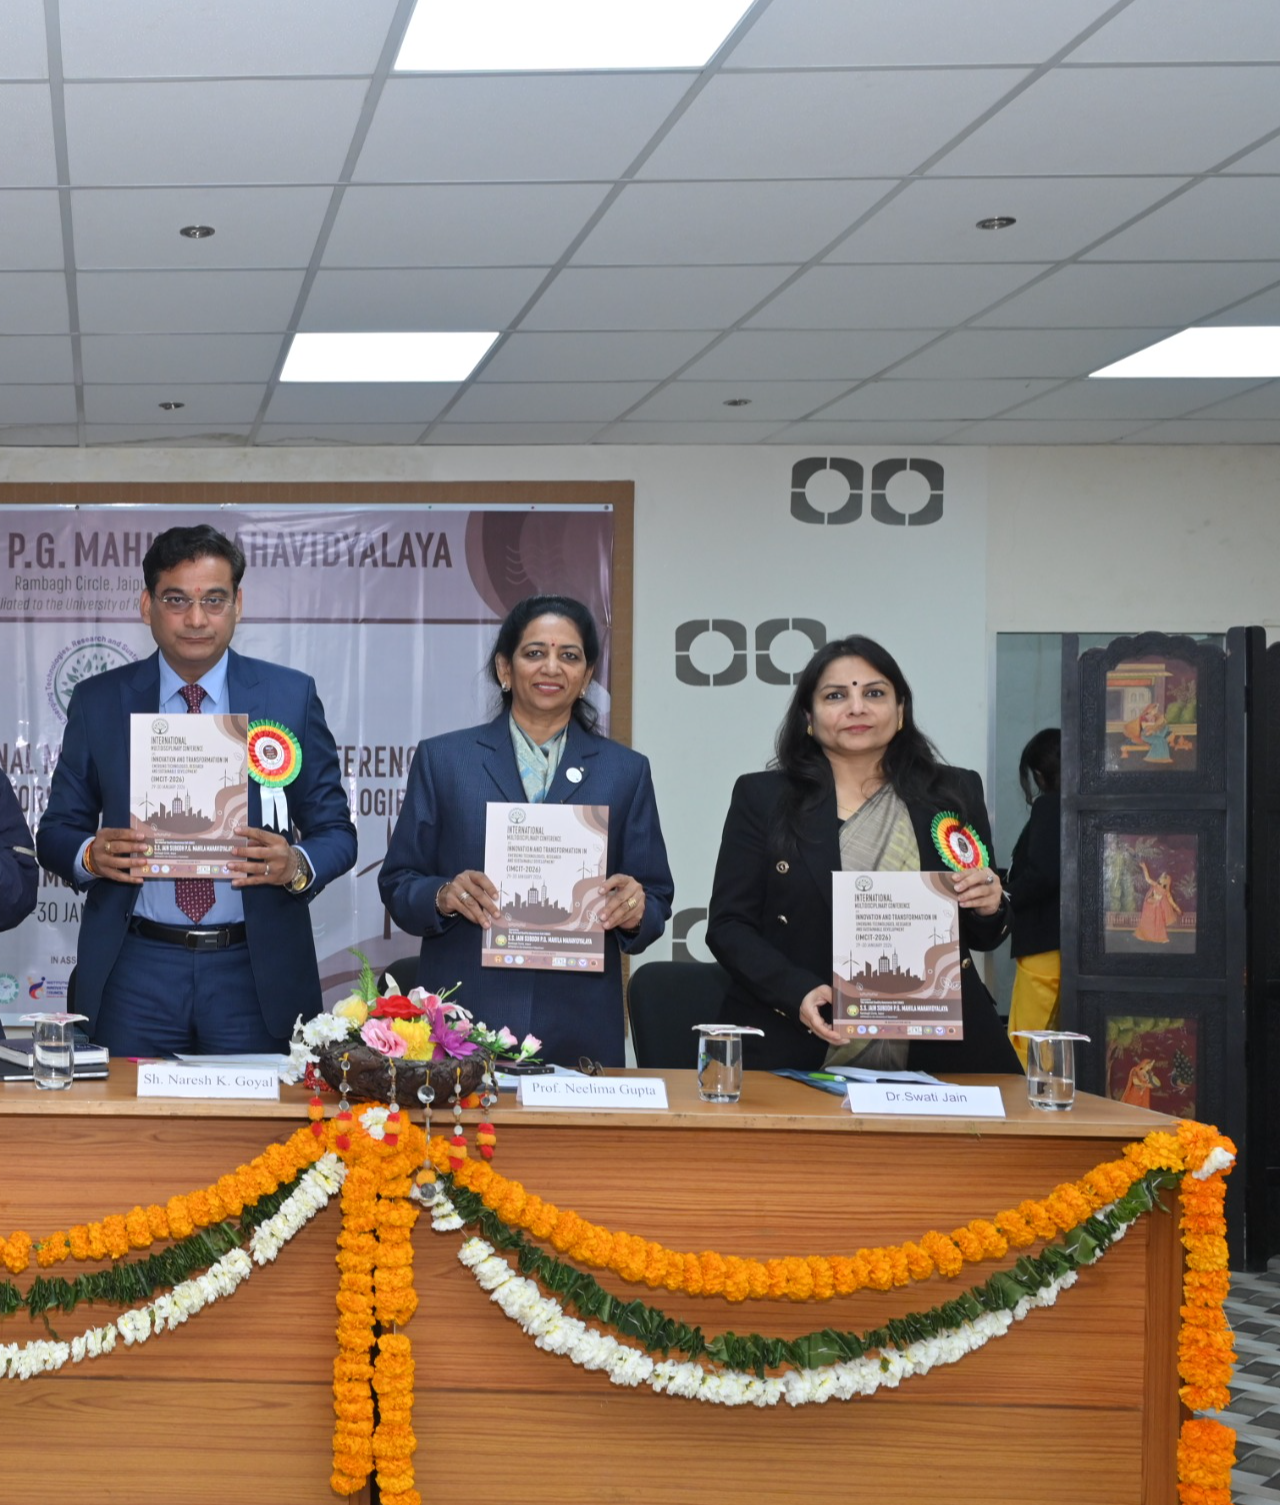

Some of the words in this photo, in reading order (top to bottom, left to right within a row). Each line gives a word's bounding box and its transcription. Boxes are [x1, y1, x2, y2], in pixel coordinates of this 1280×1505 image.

[8, 532, 66, 569] P.G.
[15, 576, 71, 594] Rambagh
[76, 576, 113, 592] Circle,
[116, 576, 147, 594] Jaipu
[32, 598, 42, 610] to
[45, 598, 62, 610] the
[66, 598, 116, 613] University
[119, 598, 130, 611] of
[151, 736, 186, 744] INTERNATIONAL
[507, 825, 544, 834] INTERNATIONAL
[855, 894, 892, 902] INTERNATIONAL
[51, 956, 59, 964] IN
[144, 1074, 163, 1085] Sh.
[169, 1074, 212, 1085] Naresh
[216, 1076, 230, 1086] K.
[235, 1076, 273, 1089] Goyal
[532, 1082, 560, 1093] Prof.
[565, 1083, 615, 1094] Neelima
[620, 1084, 656, 1097] Gupta
[886, 1091, 938, 1102] Dr.Swati
[942, 1093, 967, 1103] Jain
